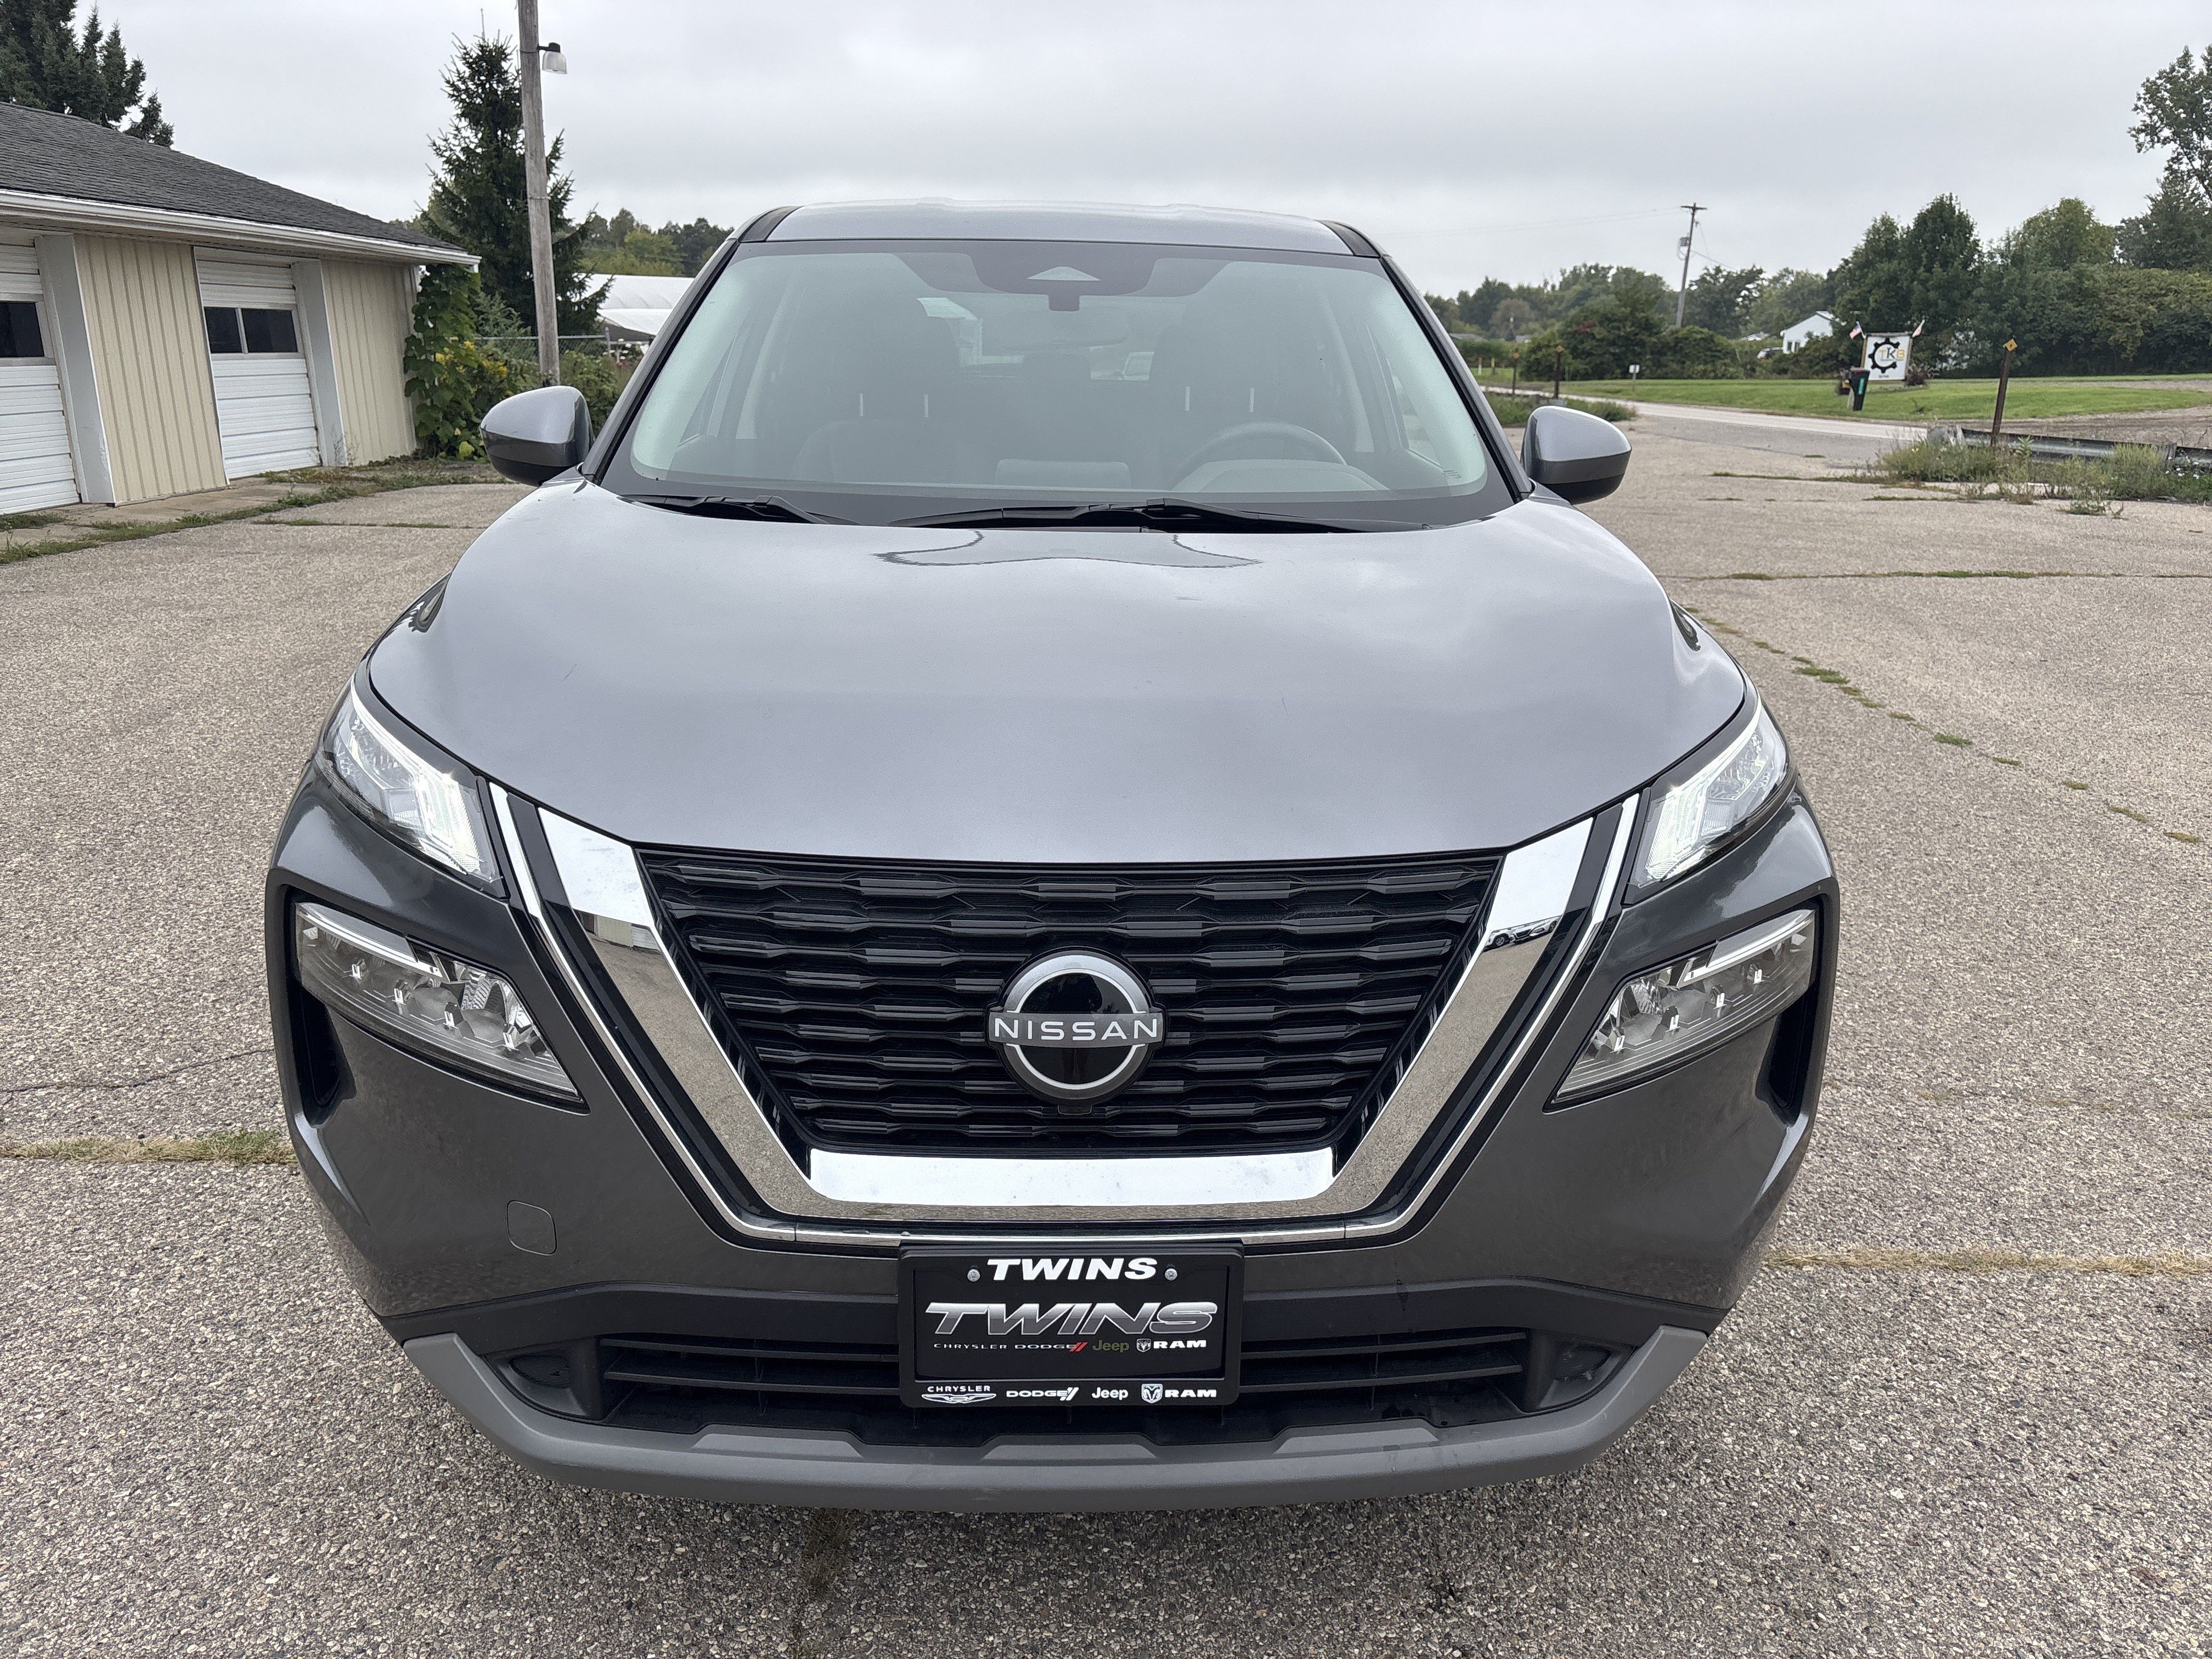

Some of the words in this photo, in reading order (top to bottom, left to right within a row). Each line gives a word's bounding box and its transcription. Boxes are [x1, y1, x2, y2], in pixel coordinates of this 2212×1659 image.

[995, 1018, 1157, 1041] NISSAN
[988, 1257, 1158, 1280] TWINS
[926, 1302, 1218, 1335] TWINS
[1092, 1340, 1130, 1353] Jeep
[1153, 1340, 1206, 1349] RAM
[1092, 1387, 1128, 1400] Jeep
[1165, 1389, 1217, 1397] RAM
